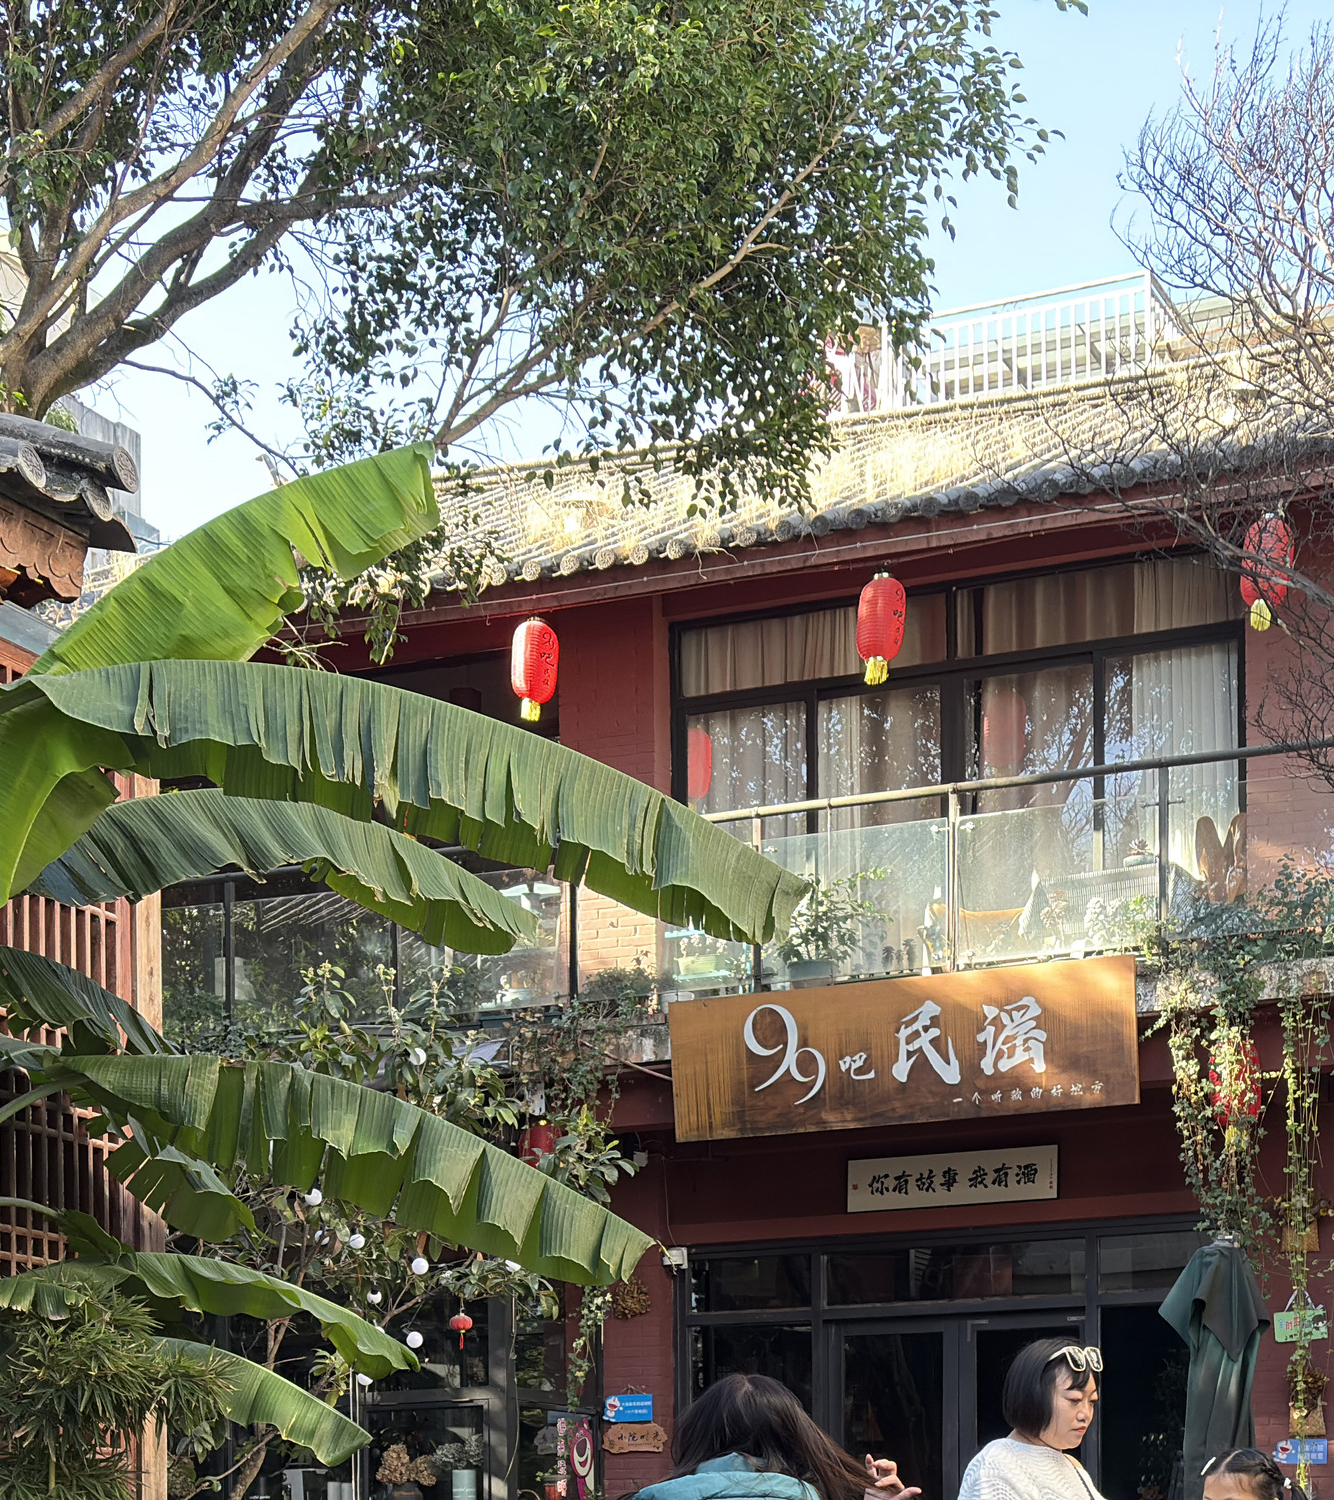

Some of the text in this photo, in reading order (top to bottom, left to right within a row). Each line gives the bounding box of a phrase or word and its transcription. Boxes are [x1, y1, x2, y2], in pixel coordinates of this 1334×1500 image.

[952, 1080, 1104, 1105] 一个听歌的好地方
[868, 1163, 958, 1196] 你有故事
[968, 1162, 1038, 1190] 我有酒
